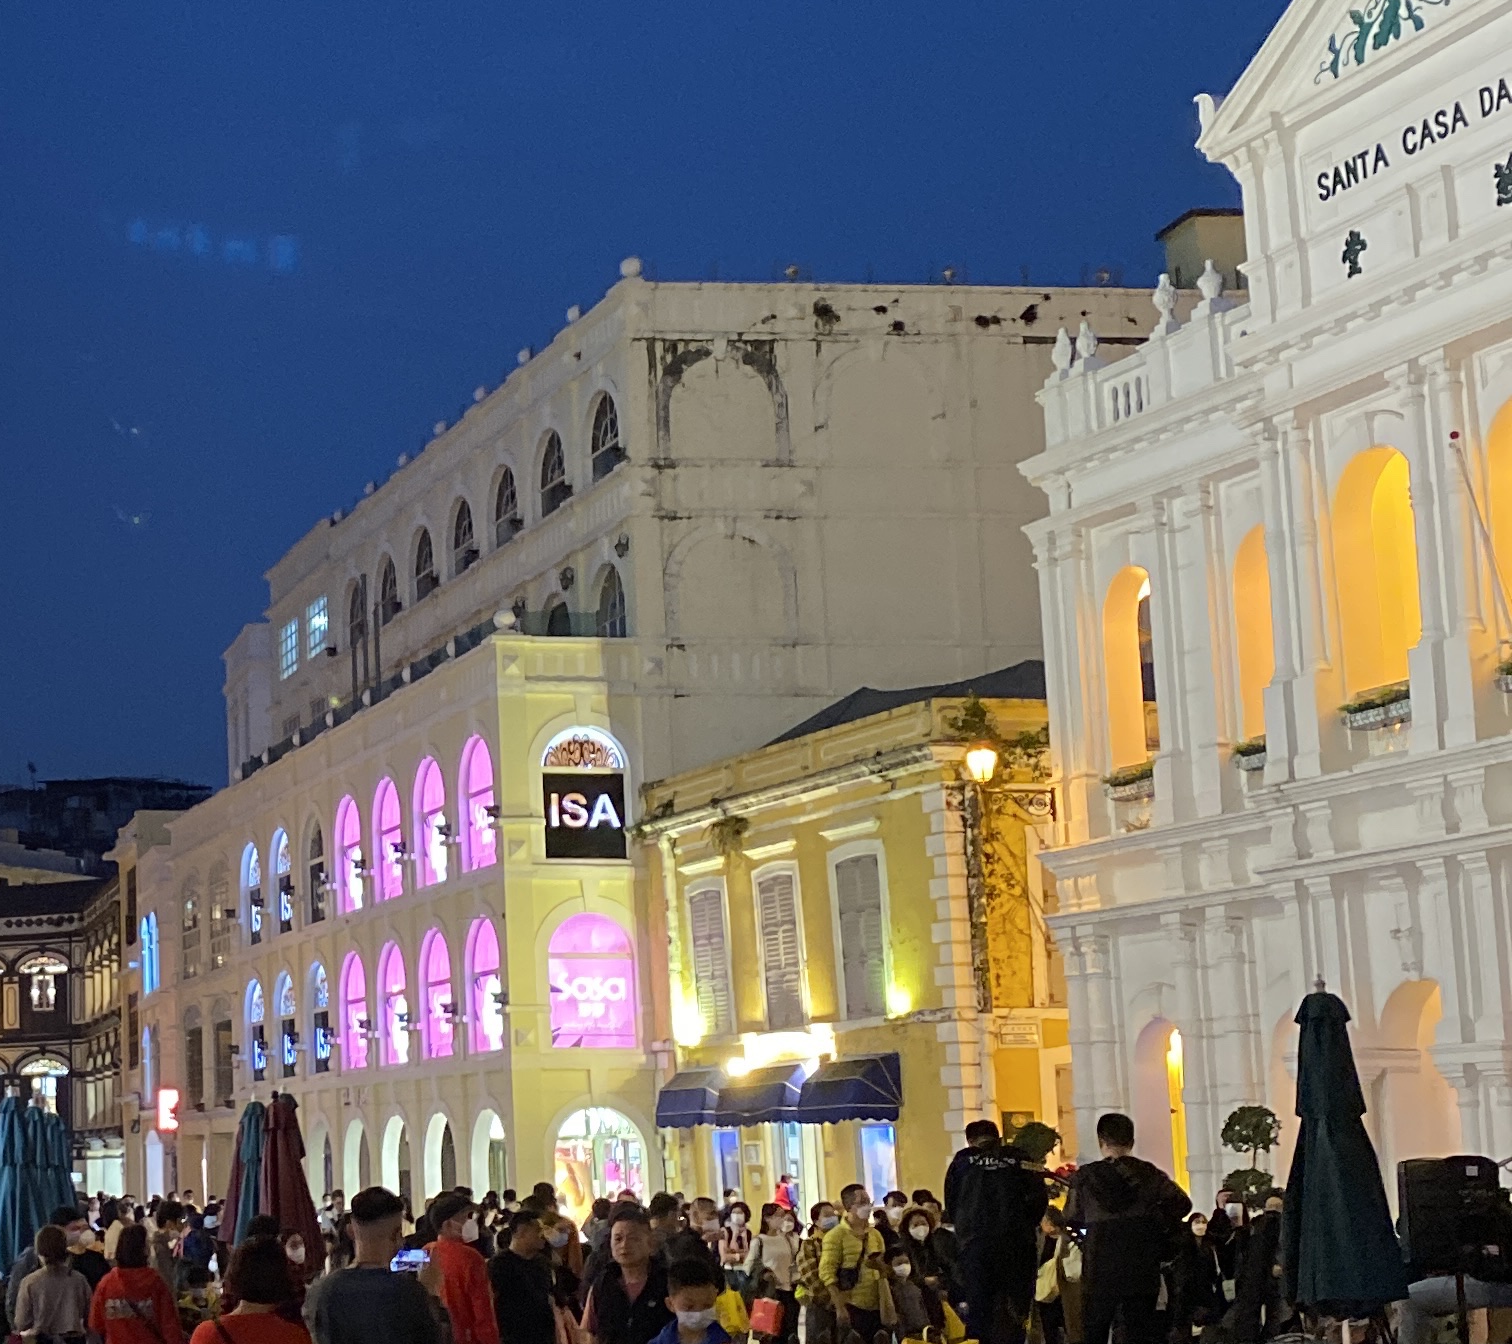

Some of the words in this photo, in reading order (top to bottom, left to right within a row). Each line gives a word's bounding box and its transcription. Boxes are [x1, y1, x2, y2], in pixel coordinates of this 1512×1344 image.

[1317, 142, 1390, 201] SANTA
[1402, 100, 1469, 155] CASA
[1479, 78, 1512, 118] DA
[550, 792, 622, 828] ISA
